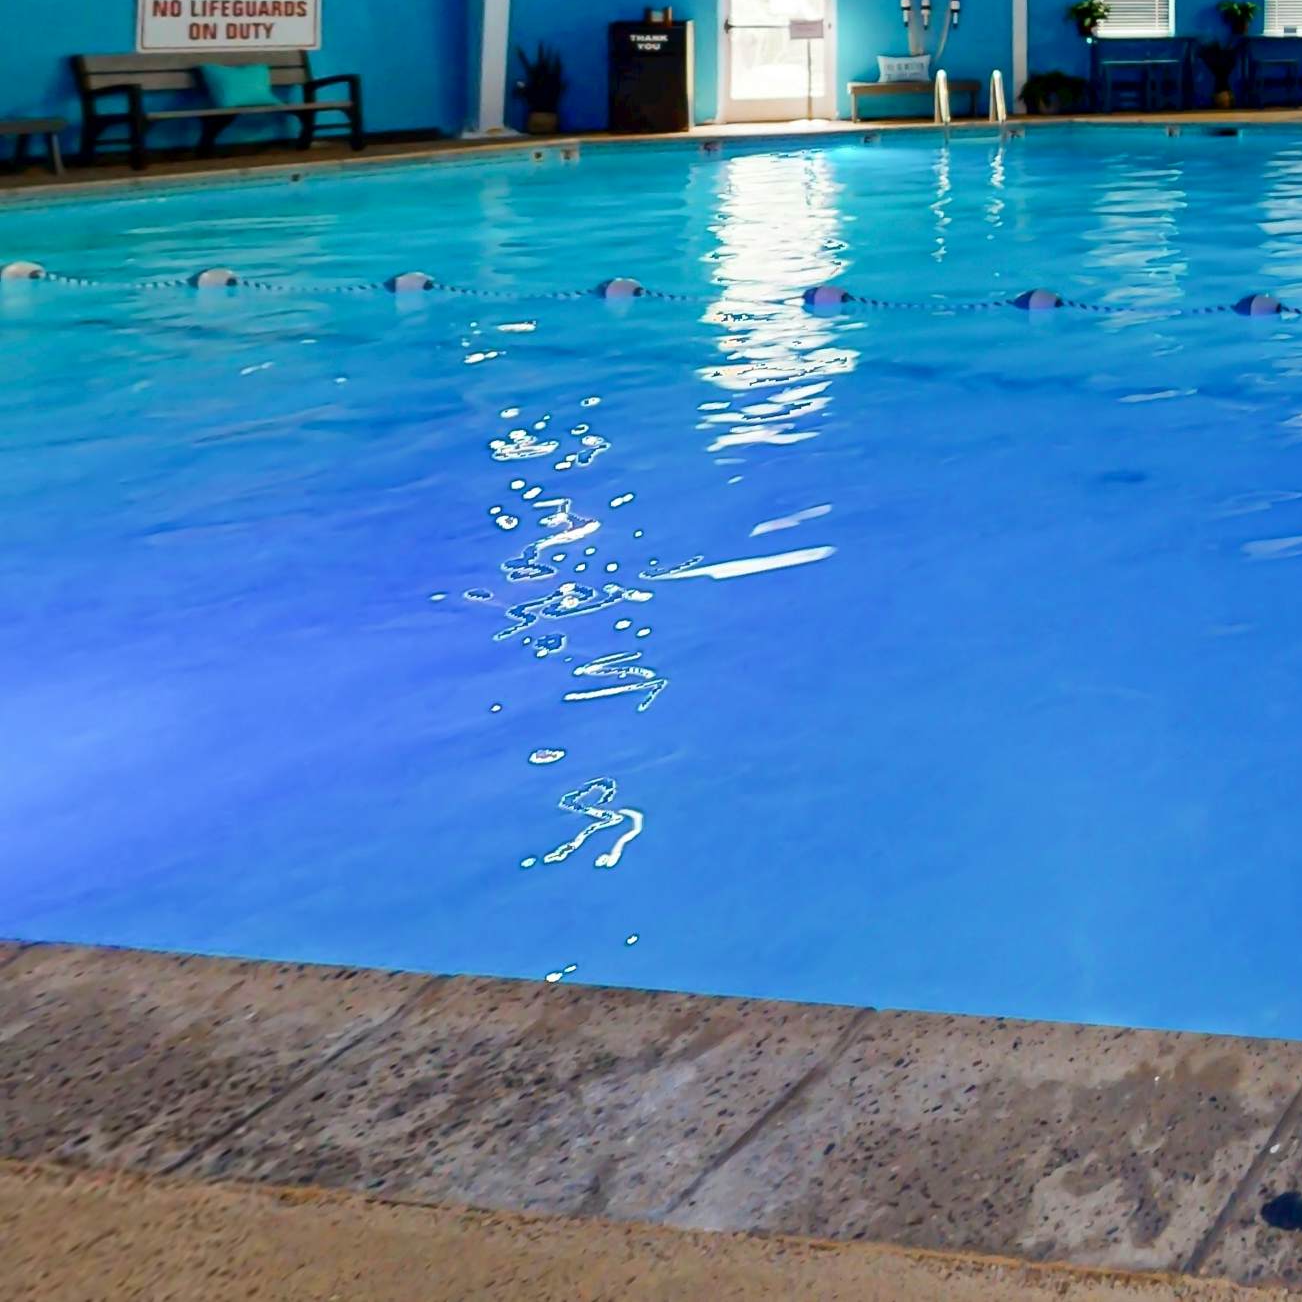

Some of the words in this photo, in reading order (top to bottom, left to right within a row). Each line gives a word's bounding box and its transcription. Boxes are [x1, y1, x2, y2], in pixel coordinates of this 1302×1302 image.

[152, 0, 182, 17] NO
[190, 0, 307, 17] LIFEGUARDS
[188, 22, 217, 40] ON
[226, 23, 274, 40] DUTY
[629, 34, 668, 42] THANK
[637, 43, 661, 51] YOU
